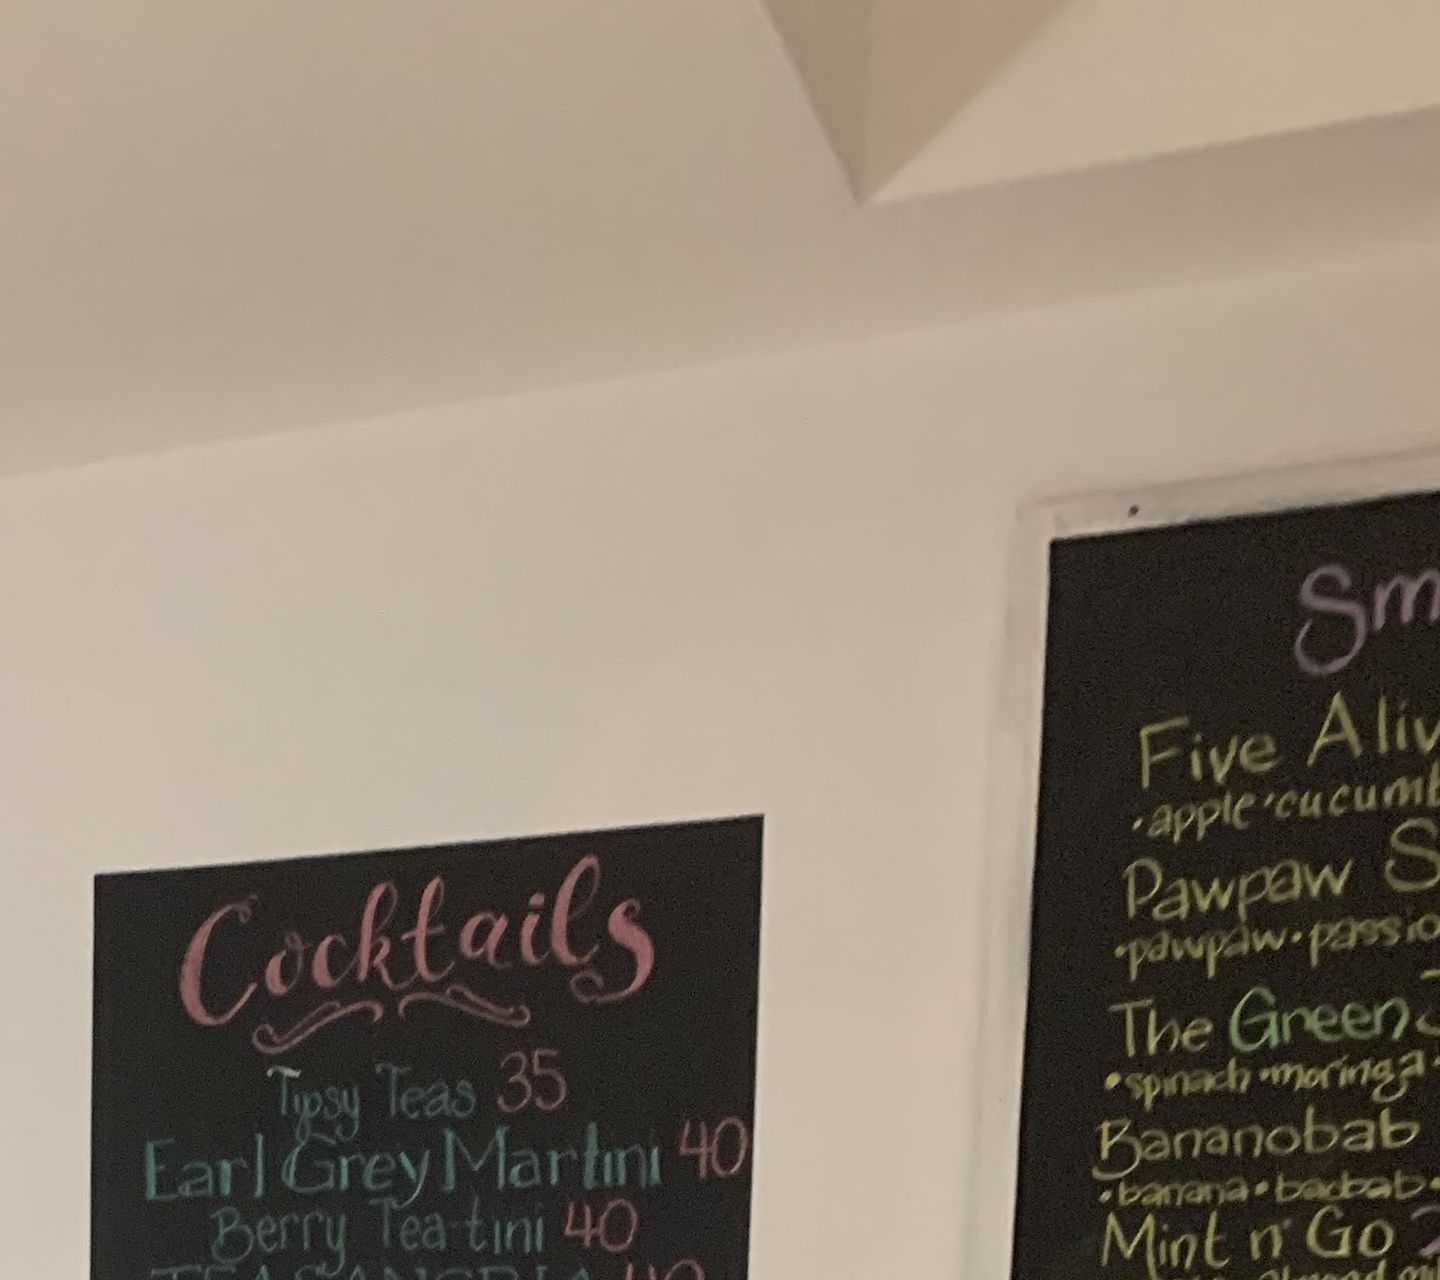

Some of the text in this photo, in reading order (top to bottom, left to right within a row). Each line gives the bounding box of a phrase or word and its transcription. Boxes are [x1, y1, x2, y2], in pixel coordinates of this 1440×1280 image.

[1140, 690, 1440, 790] Five Aliv
[1147, 791, 1257, 844] apple
[1122, 816, 1440, 922] Pawpaw S
[179, 854, 655, 1027] Cocktails
[1127, 924, 1287, 983] pawpaw
[1108, 999, 1214, 1058] The
[1229, 986, 1410, 1053] Green
[266, 1048, 568, 1142] Tipsy Teas 35
[144, 1116, 749, 1208] Earl Grey Martini 40
[1091, 1104, 1421, 1180] Bananobab
[210, 1205, 347, 1277] Berry
[563, 1198, 638, 1253] 40
[1305, 1203, 1396, 1259] Go
